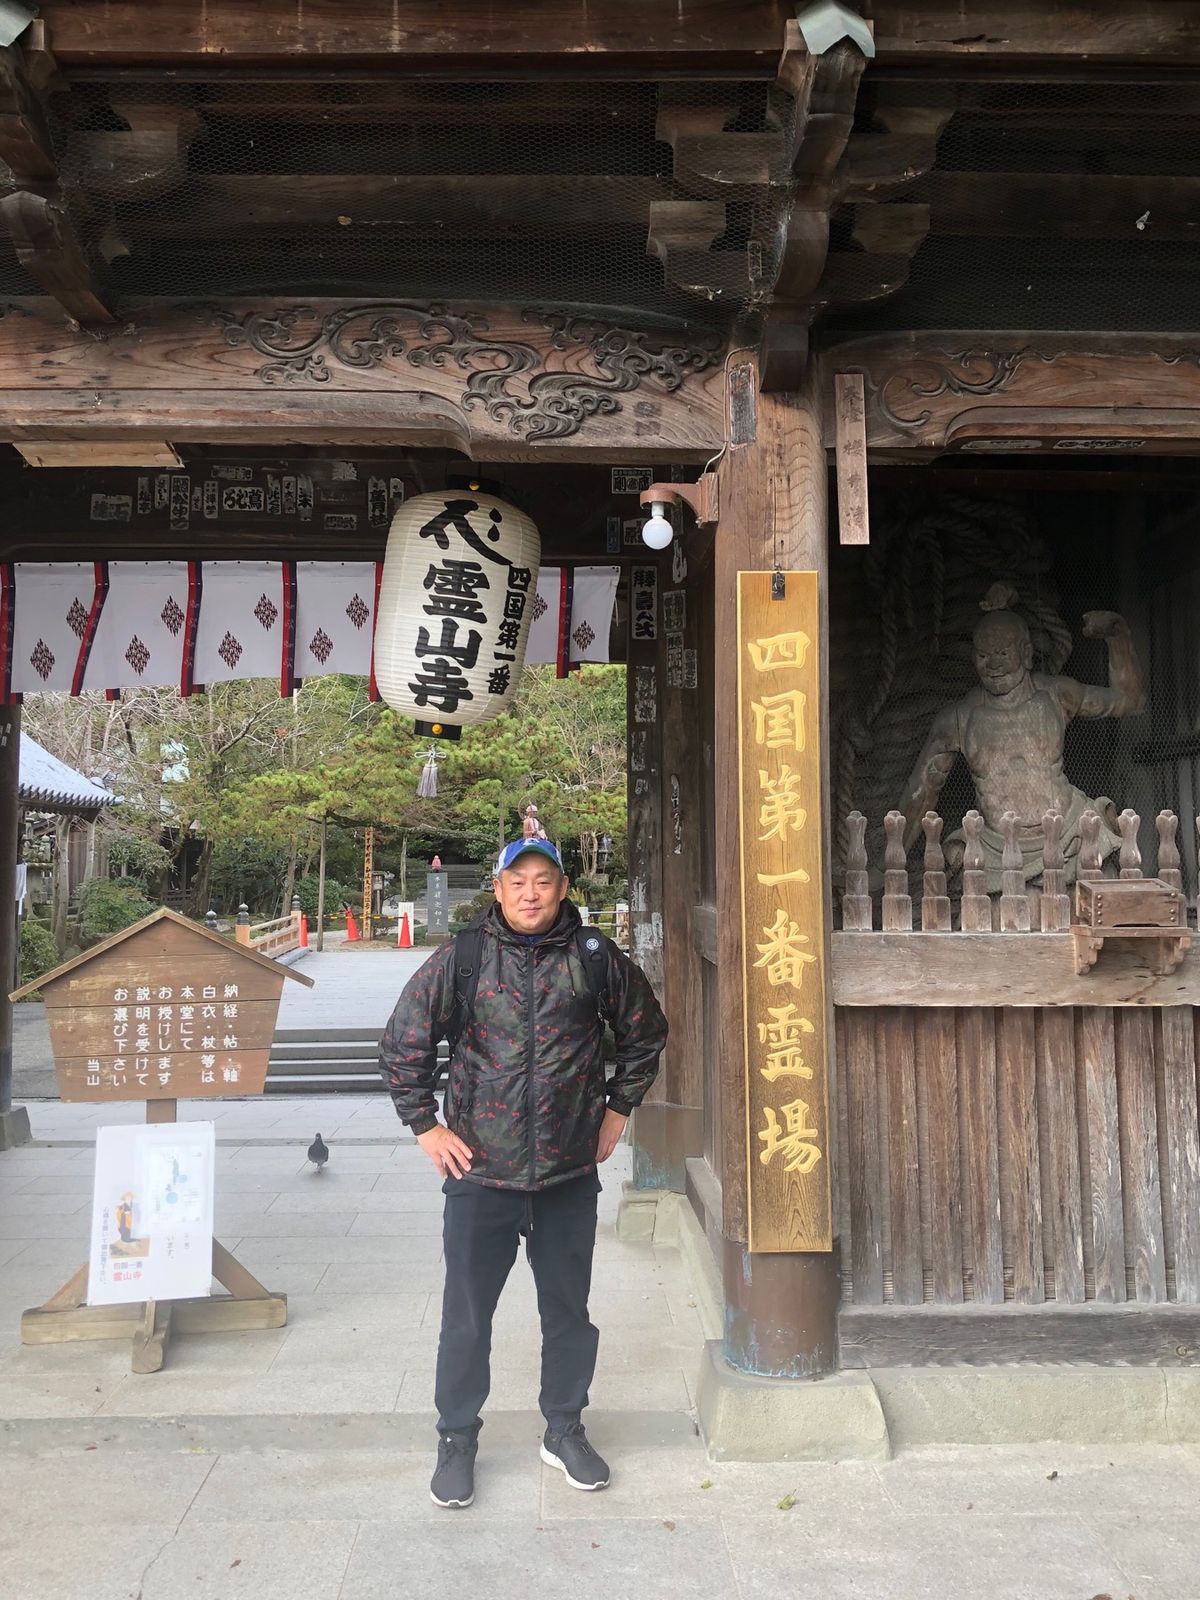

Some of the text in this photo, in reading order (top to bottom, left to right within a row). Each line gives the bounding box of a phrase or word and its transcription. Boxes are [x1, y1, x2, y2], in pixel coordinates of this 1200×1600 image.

[408, 558, 490, 714] 霊山寺
[484, 564, 532, 696] 四国第一番
[746, 627, 823, 1175] 四国第一番霊場
[113, 987, 128, 1087] お選び下さい
[135, 986, 151, 1087] 説明を受けて
[157, 984, 173, 1085] お授けします
[180, 984, 195, 1050] 本堂にて
[86, 1058, 101, 1087] 当山
